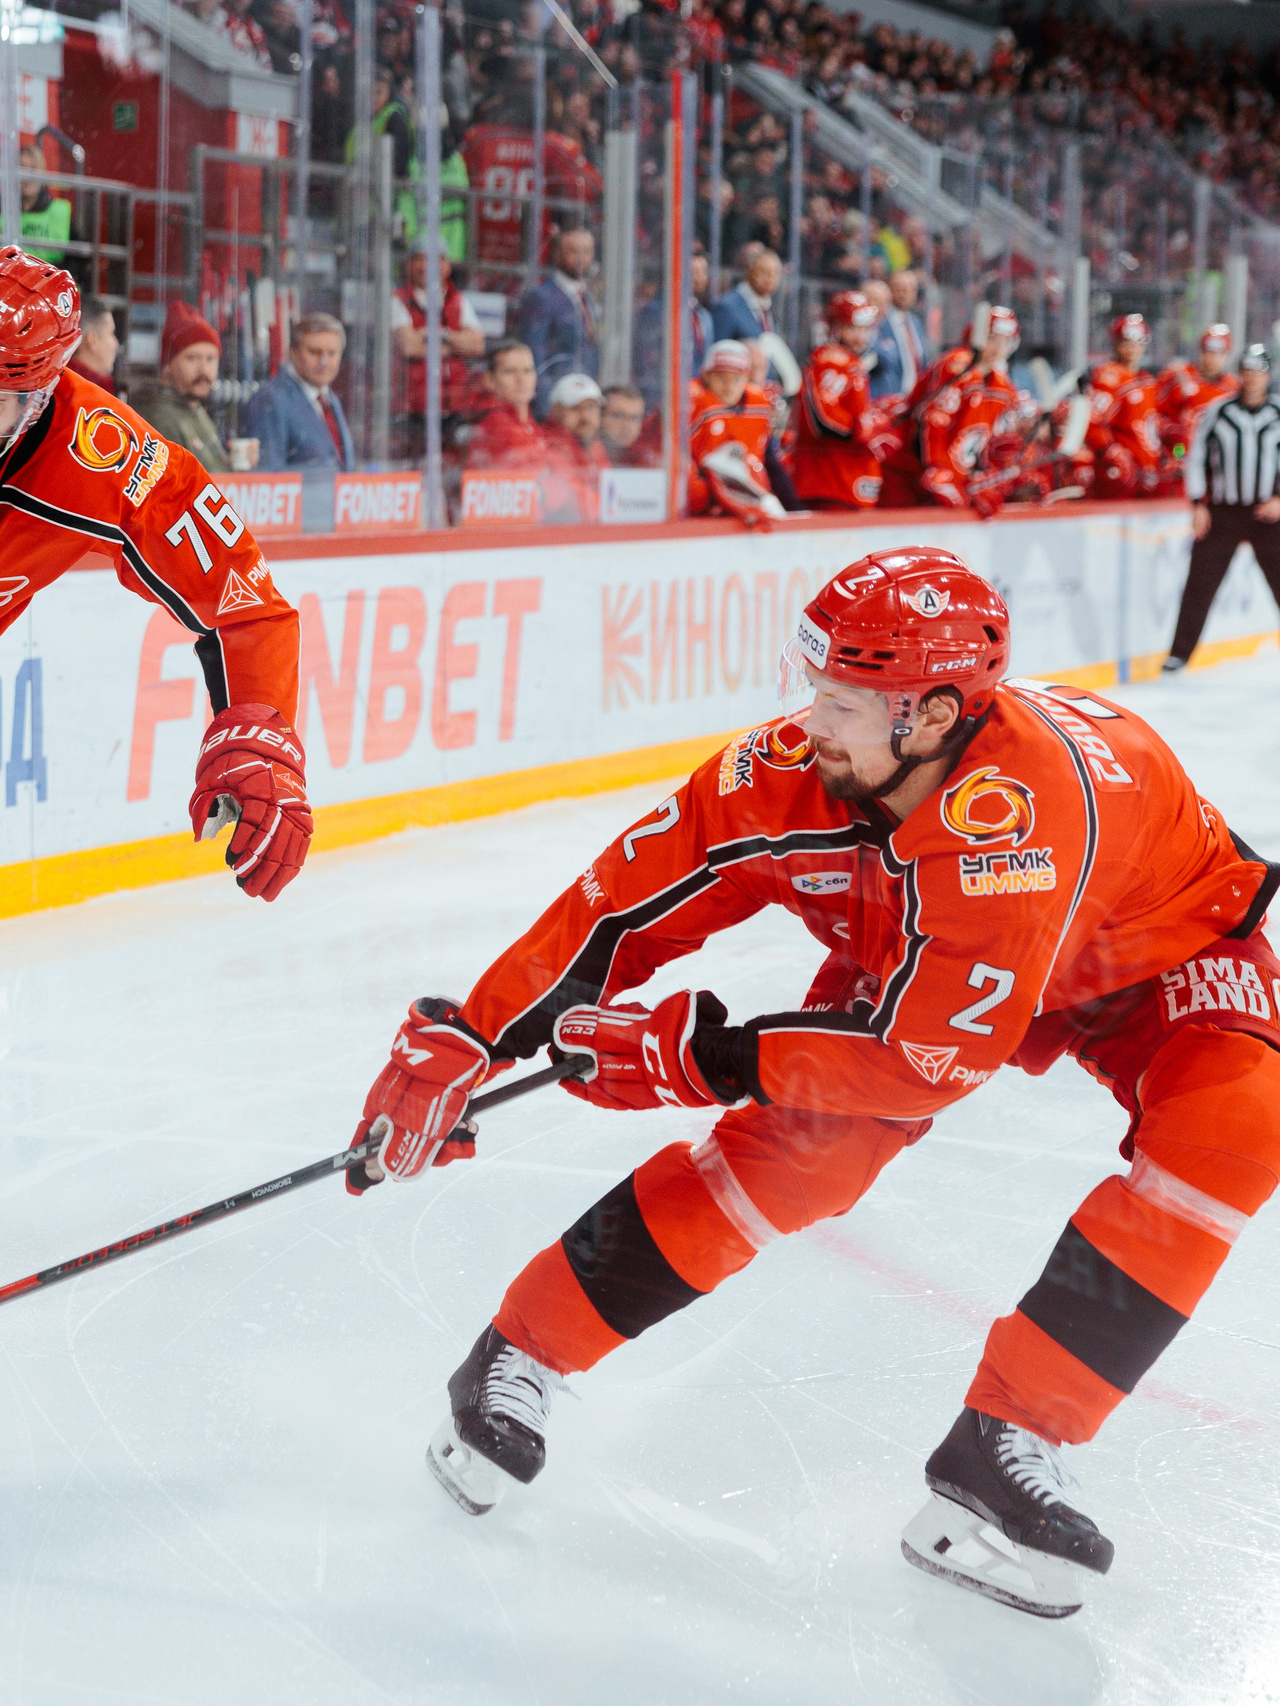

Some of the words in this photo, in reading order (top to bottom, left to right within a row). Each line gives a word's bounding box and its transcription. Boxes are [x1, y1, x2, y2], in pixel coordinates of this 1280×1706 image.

[124, 433, 158, 498] УГМК
[132, 441, 169, 506] UMMC
[336, 481, 420, 523] FONBET
[462, 479, 537, 519] FONBET
[164, 483, 244, 575] 76
[601, 565, 837, 714] КИНОПО
[932, 657, 976, 672] CCM
[126, 577, 544, 803] FNBET
[623, 795, 680, 863] 2
[961, 847, 1053, 875] УГМК
[961, 870, 1056, 896] UMMC
[1160, 957, 1264, 992] SIMA
[948, 962, 1016, 1036] 2
[1165, 981, 1270, 1022] LAND
[251, 1176, 293, 1199] ZBOROVICH
